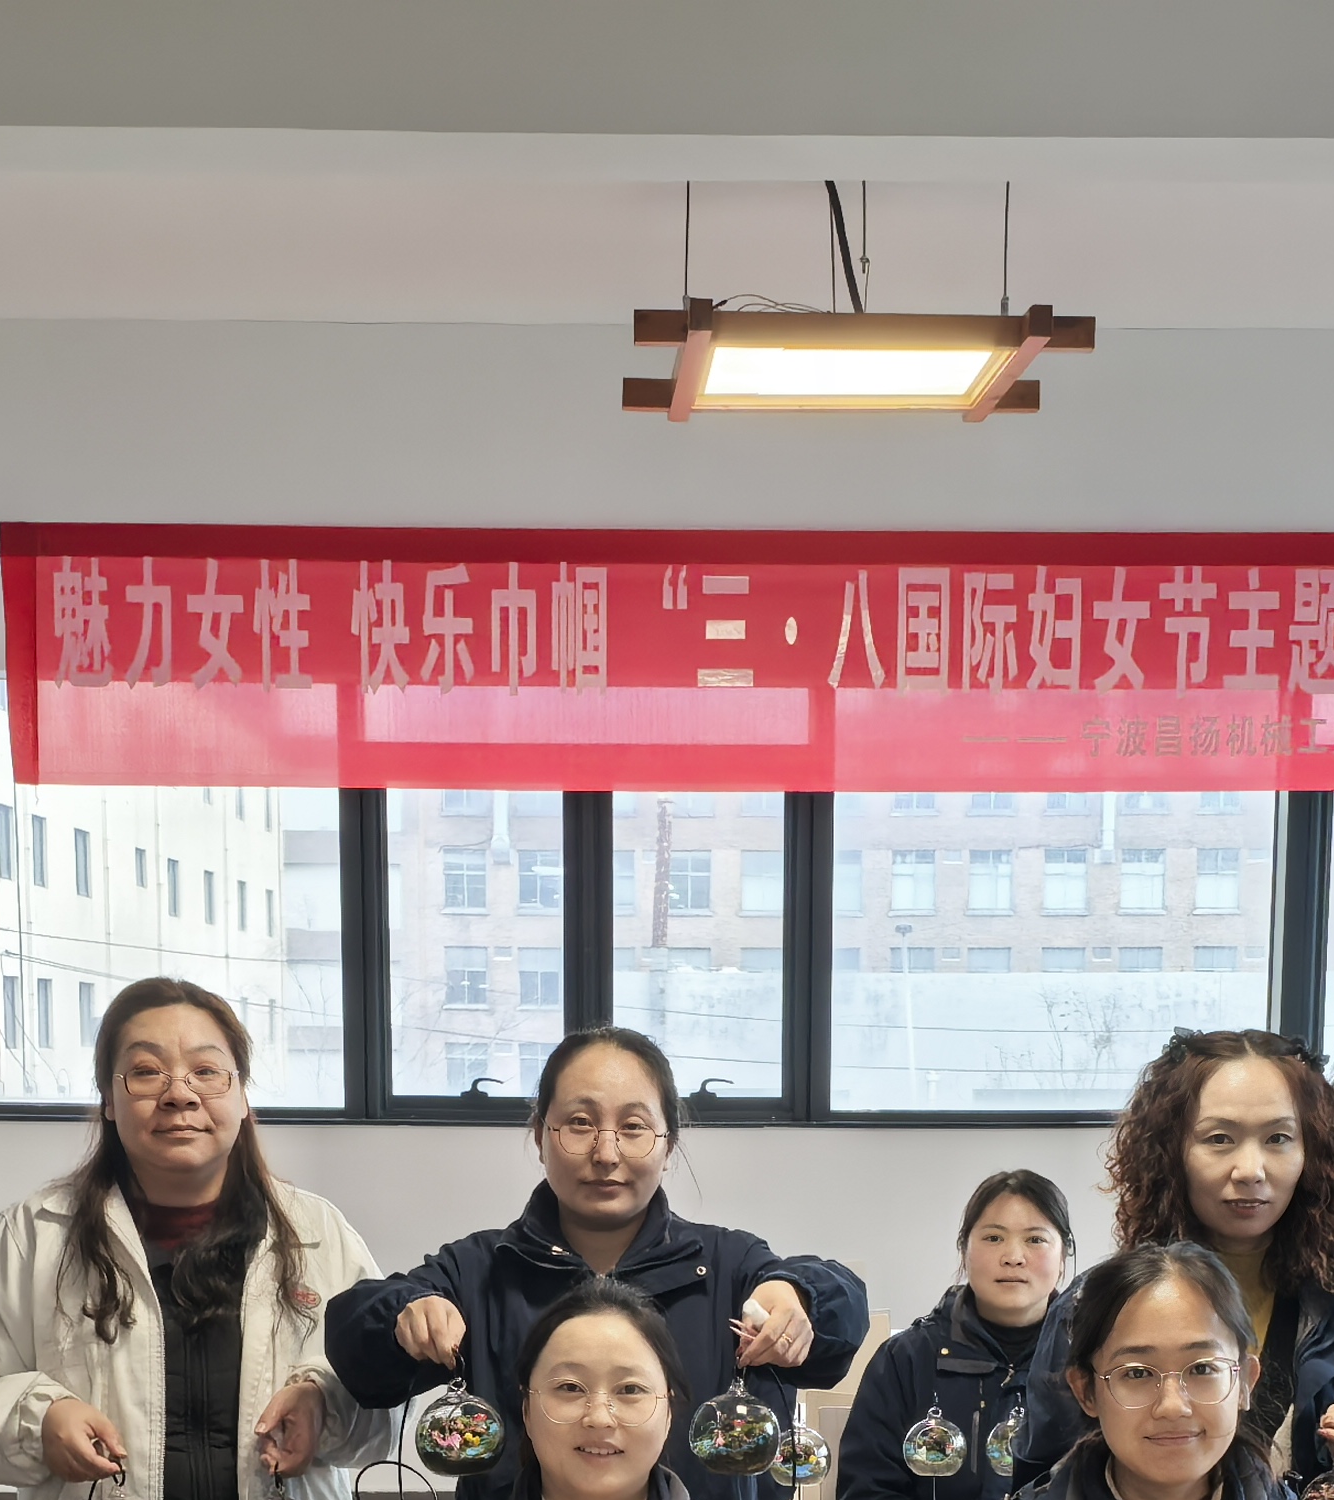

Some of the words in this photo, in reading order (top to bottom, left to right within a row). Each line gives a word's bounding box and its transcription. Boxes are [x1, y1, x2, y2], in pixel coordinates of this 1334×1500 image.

[52, 556, 313, 690] 魅力女性
[350, 557, 608, 697] 快乐巾帼
